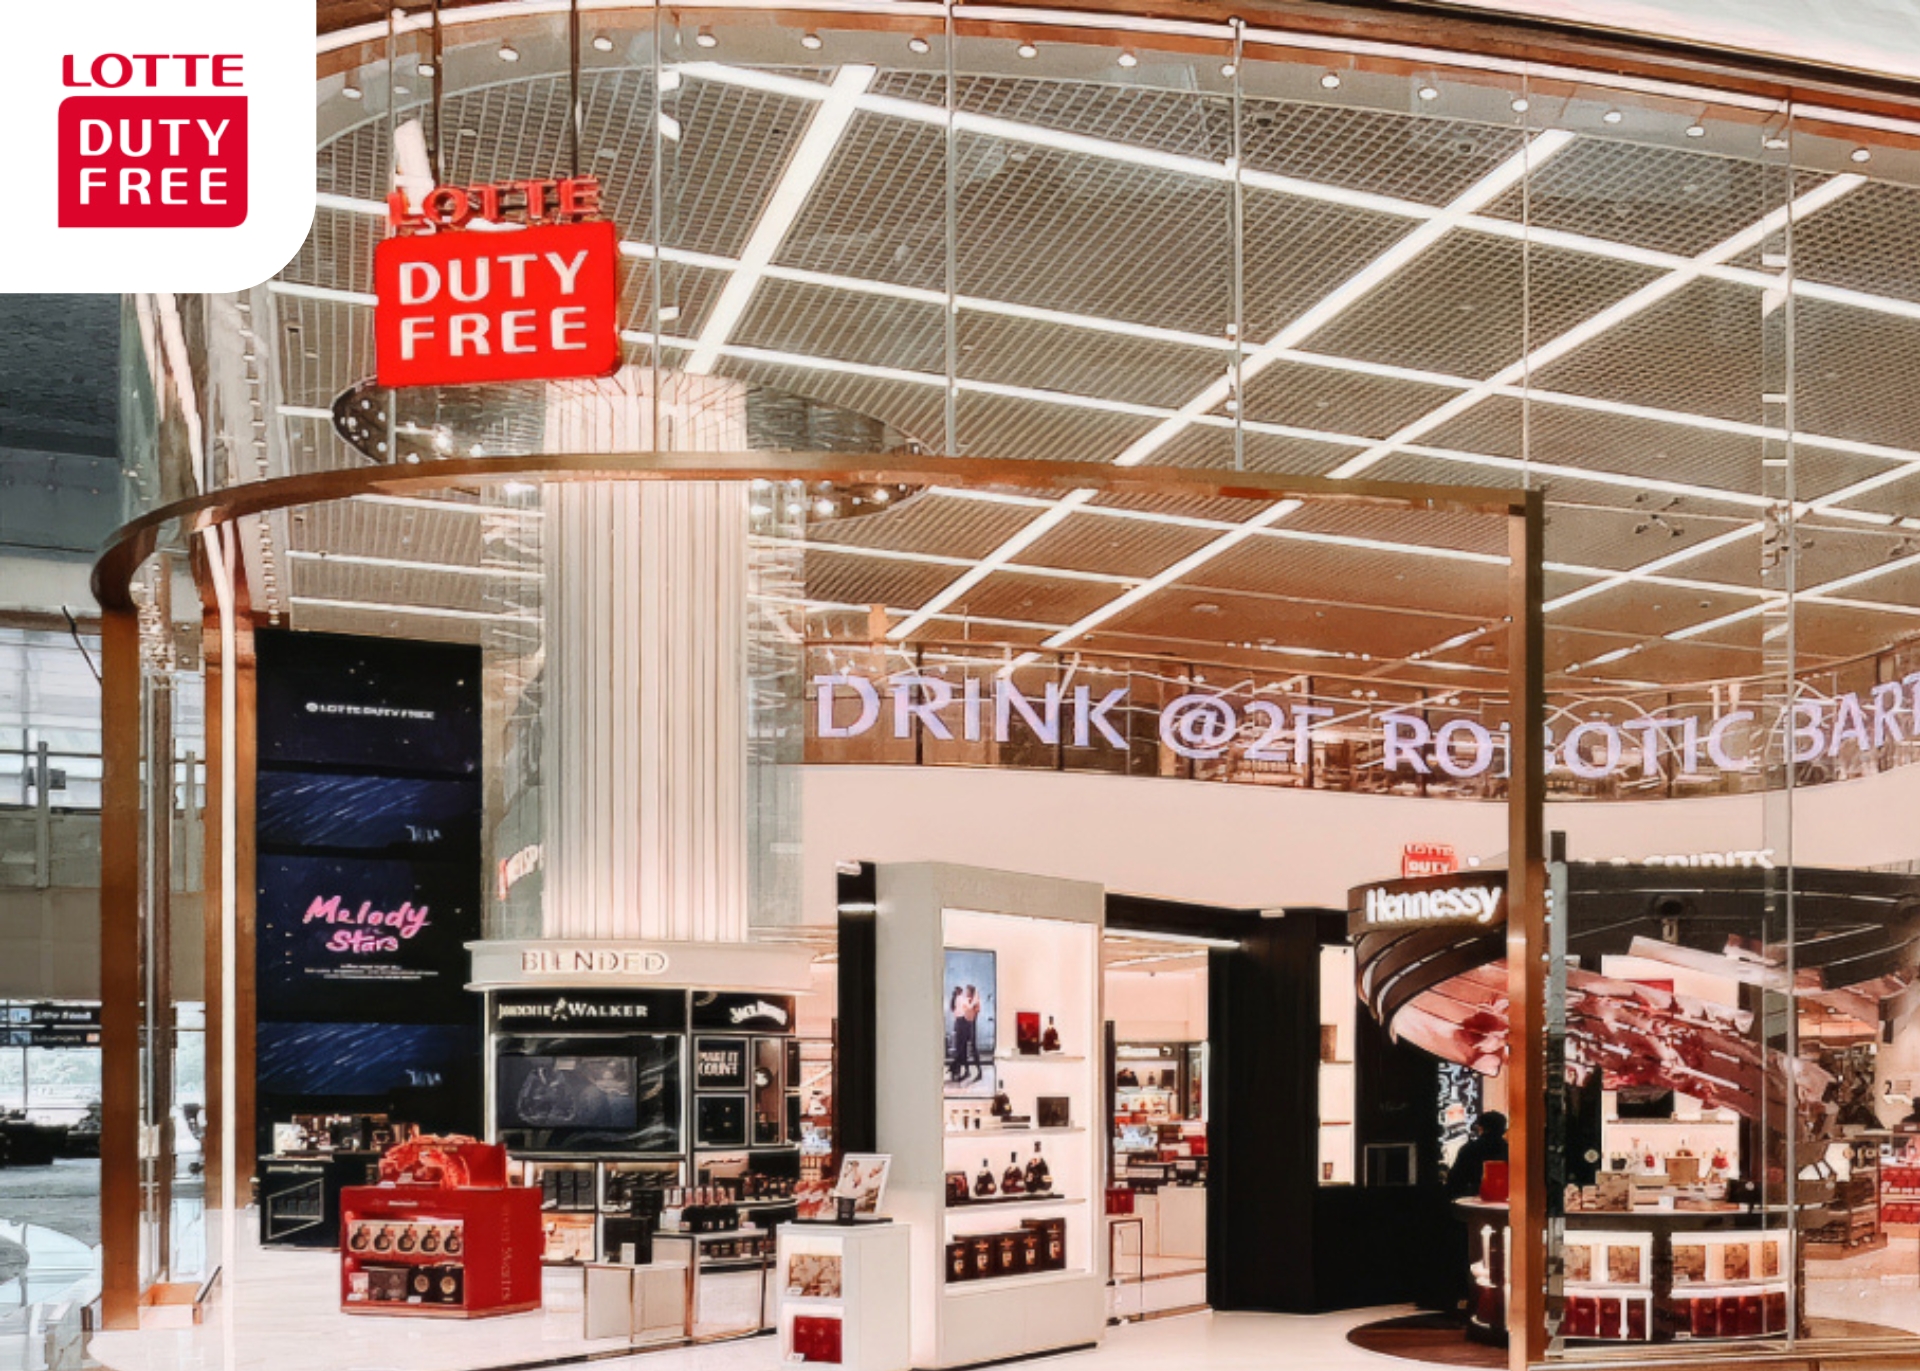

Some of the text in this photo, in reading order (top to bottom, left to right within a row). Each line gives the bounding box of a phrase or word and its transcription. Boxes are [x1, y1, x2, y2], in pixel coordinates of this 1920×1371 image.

[387, 174, 600, 230] LOTTE
[399, 249, 589, 306] DUTY
[400, 306, 587, 361] FREE
[319, 704, 361, 715] LOTTE
[814, 674, 1130, 750] DRINK
[302, 895, 431, 939] Melody
[1366, 885, 1502, 923] Hennessy
[325, 929, 399, 953] Stars
[568, 1001, 648, 1017] WALKER
